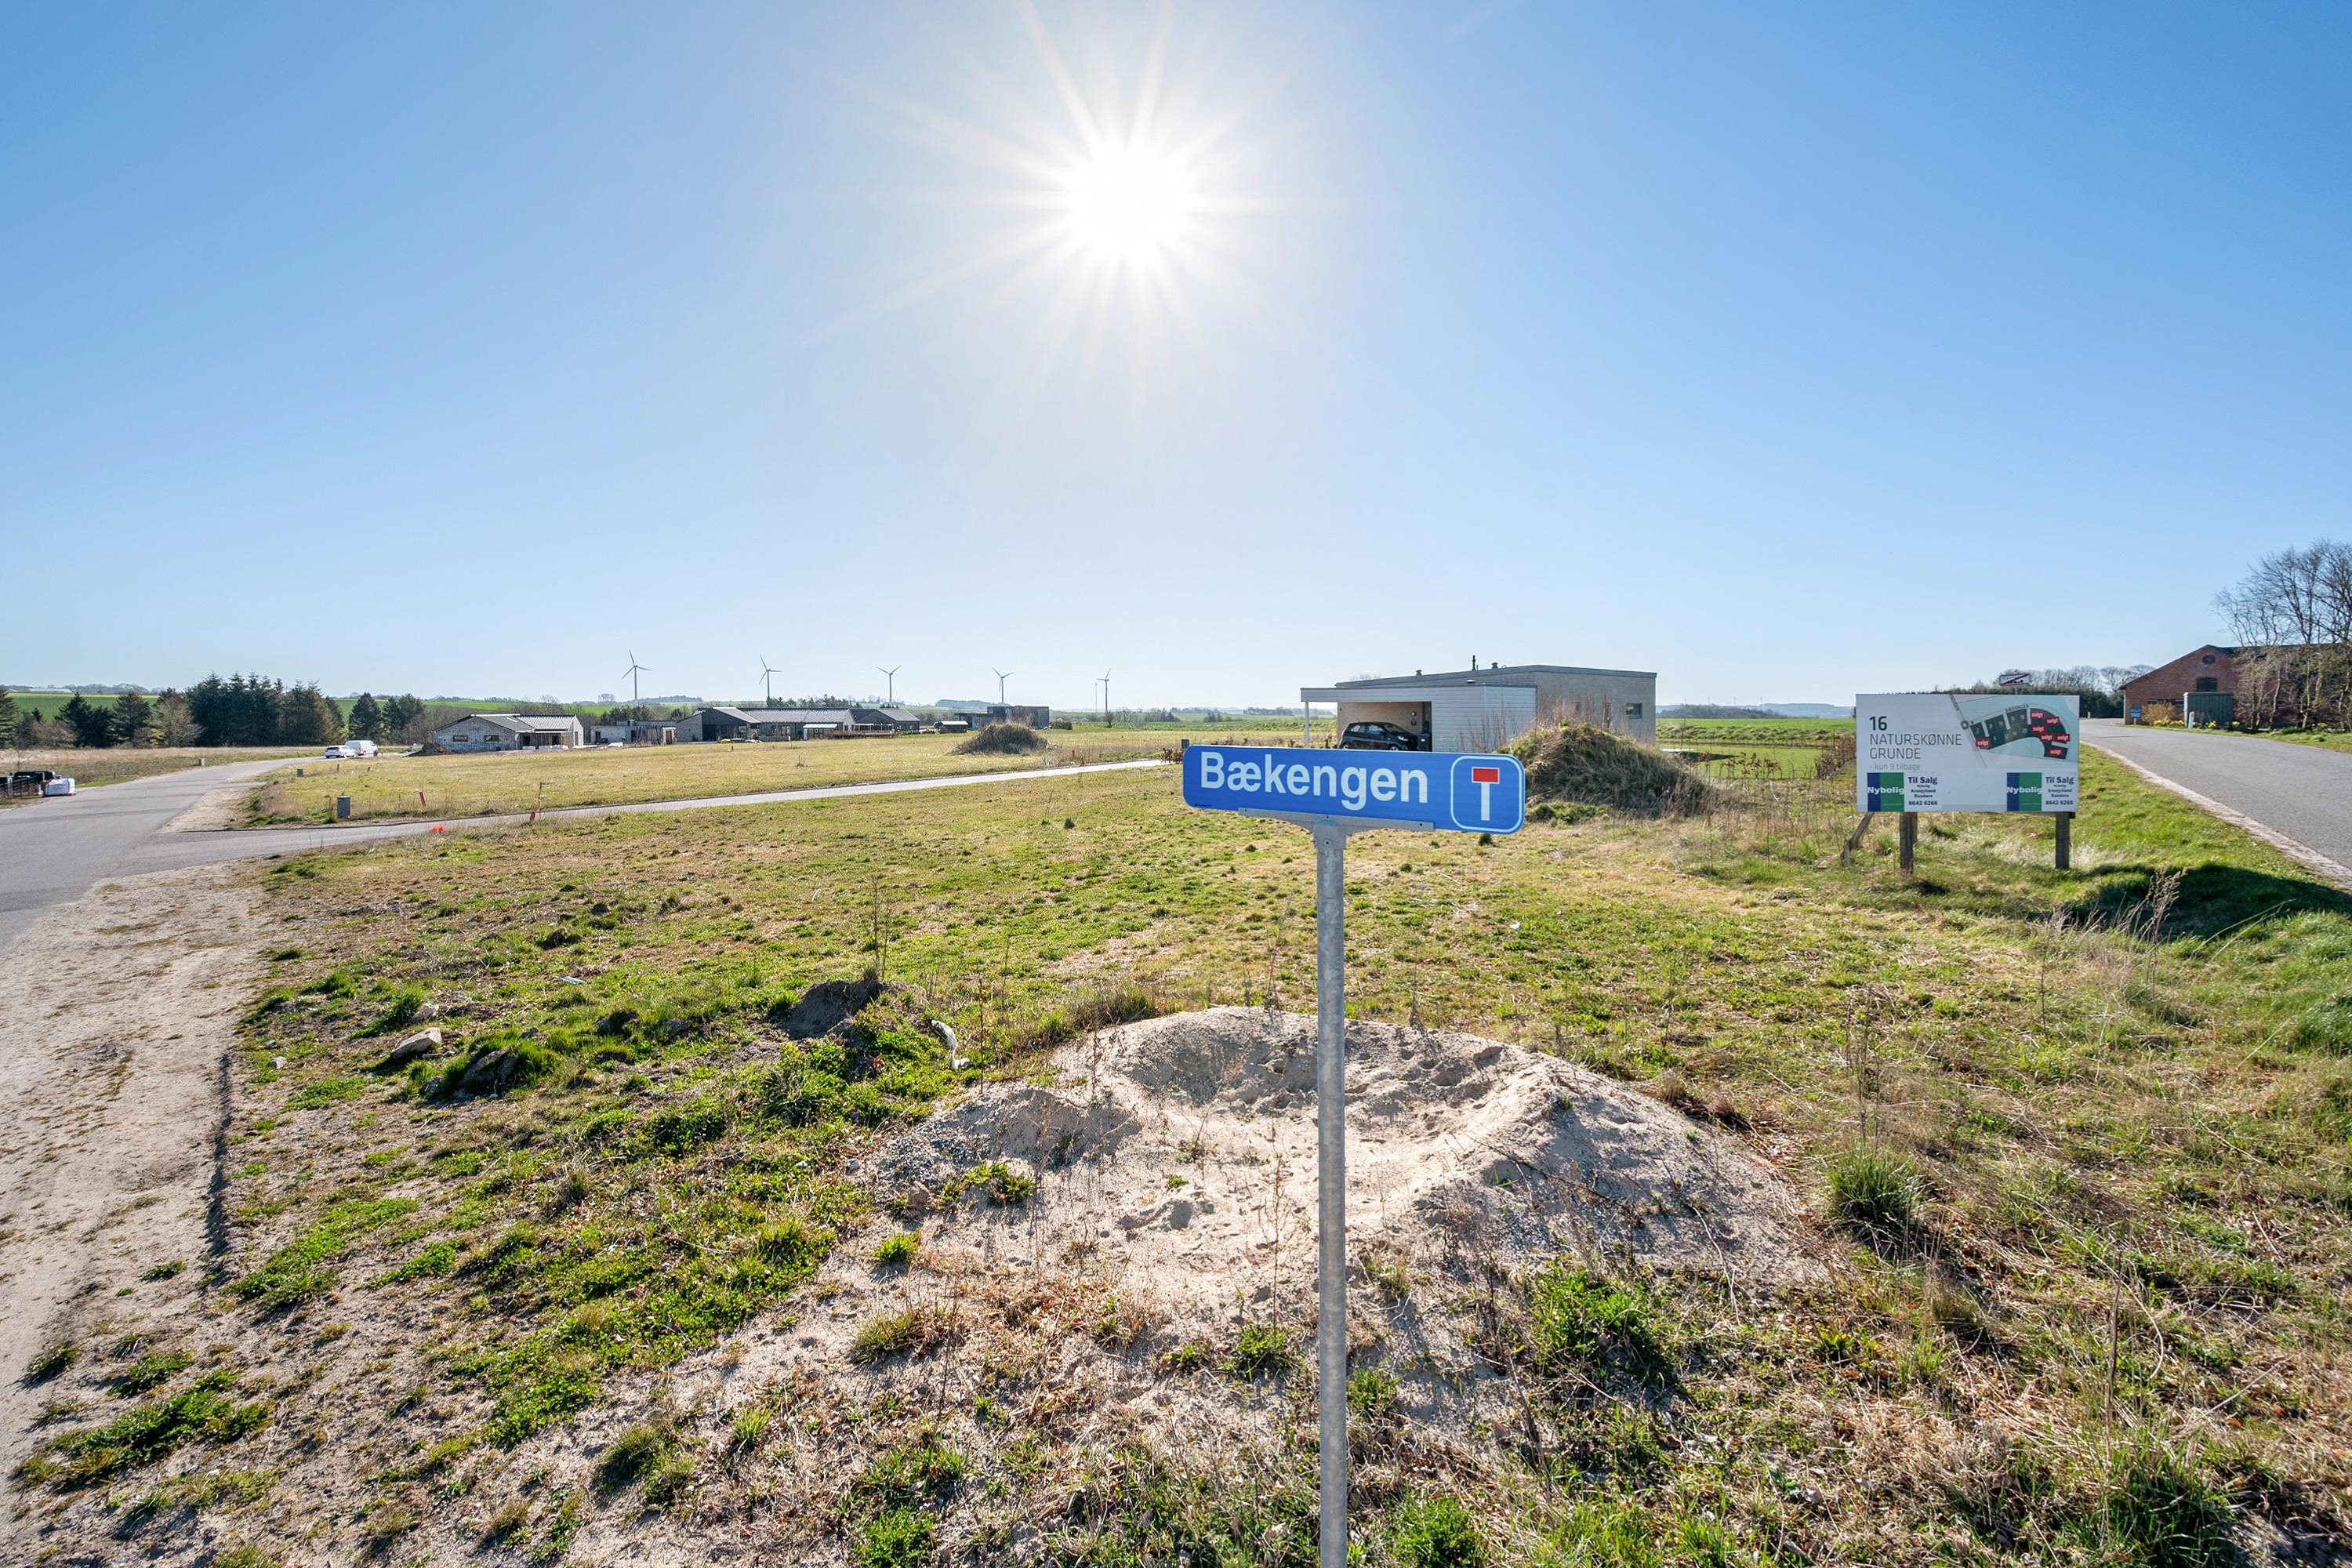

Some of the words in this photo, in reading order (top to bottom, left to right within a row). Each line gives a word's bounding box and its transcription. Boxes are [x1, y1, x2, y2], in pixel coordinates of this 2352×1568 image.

[1869, 716, 1888, 731] 16
[1870, 734, 1962, 746] NATURSKØNNE
[1870, 748, 1921, 759] GRUNDE
[1896, 763, 1921, 771] tilbage
[1200, 751, 1428, 811] Bækengen
[1867, 786, 1904, 795] Nybolig
